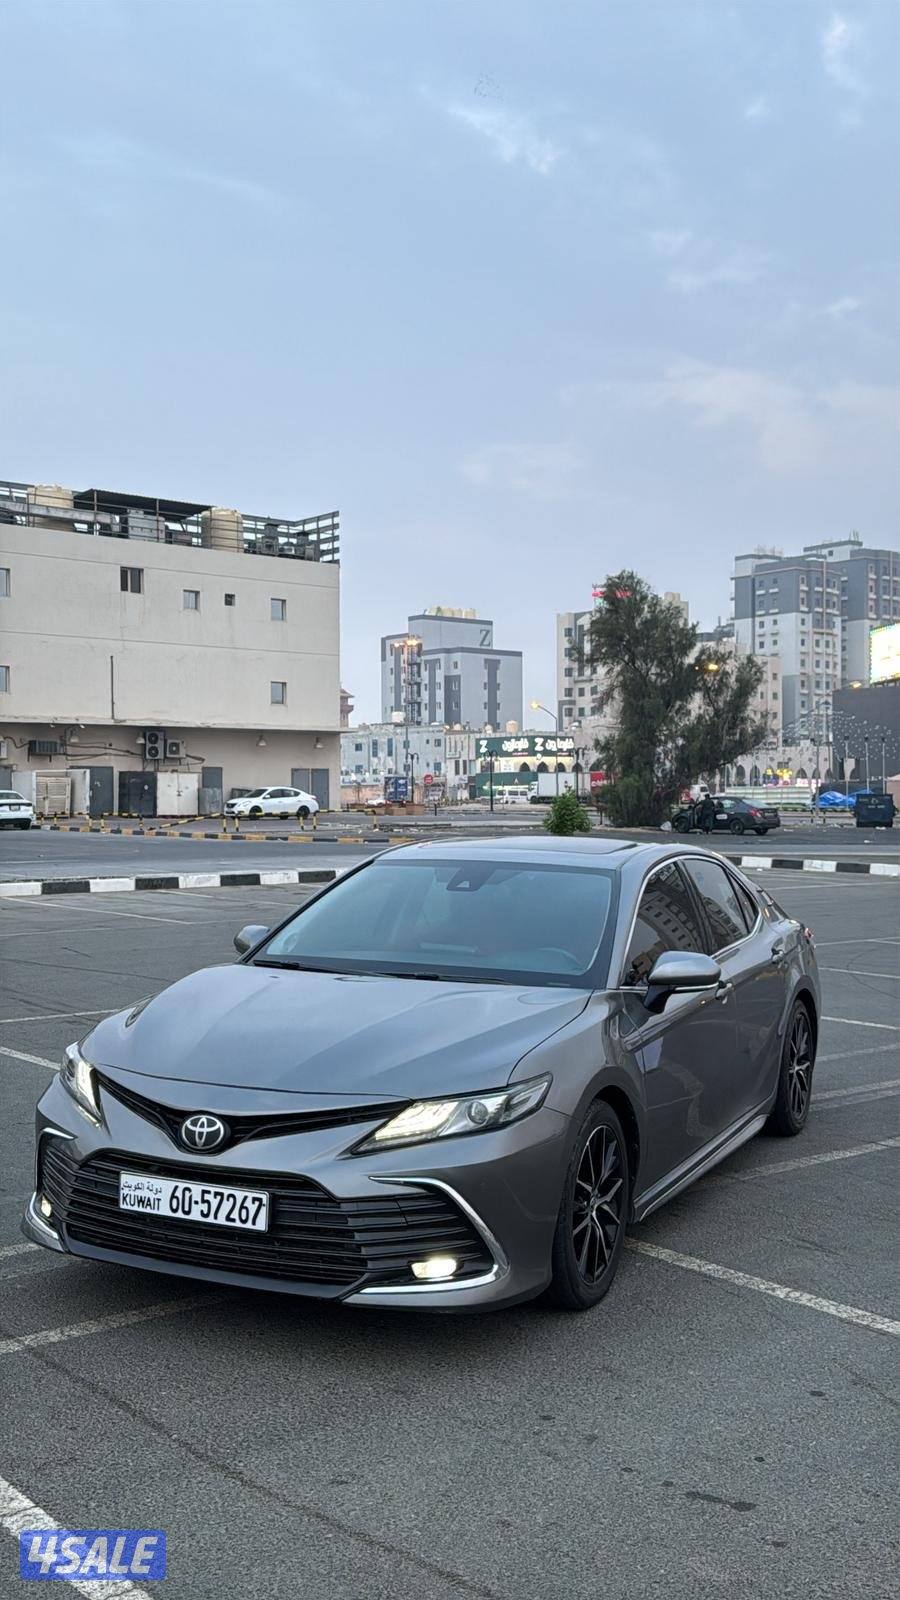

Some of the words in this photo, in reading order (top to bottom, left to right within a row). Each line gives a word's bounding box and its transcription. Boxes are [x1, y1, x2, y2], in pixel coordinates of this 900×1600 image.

[479, 629, 491, 647] Z
[534, 737, 544, 751] Z
[121, 1180, 145, 1192] الكويت
[146, 1181, 162, 1196] دولة
[122, 1193, 161, 1211] KUWAIT
[169, 1185, 263, 1226] 60-57267
